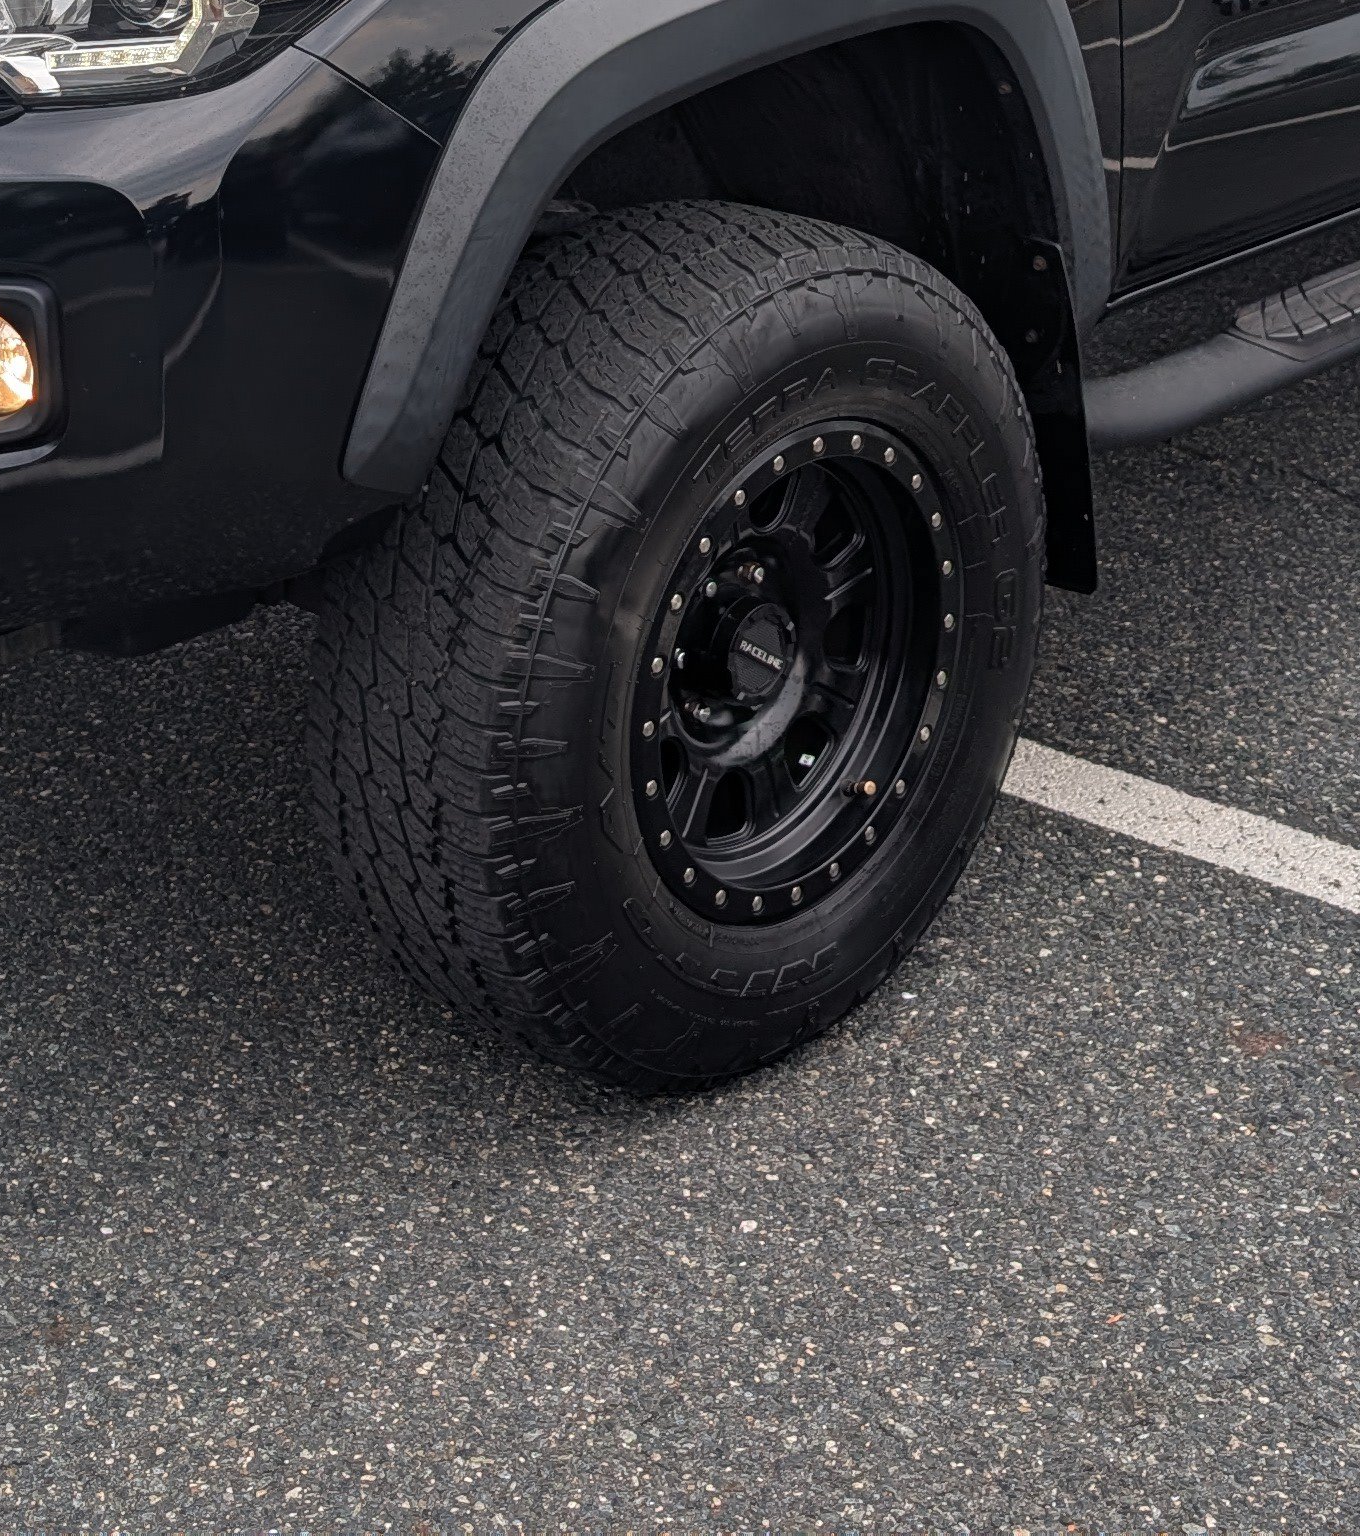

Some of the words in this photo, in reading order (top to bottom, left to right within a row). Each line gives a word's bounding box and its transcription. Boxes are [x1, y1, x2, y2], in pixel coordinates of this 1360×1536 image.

[693, 366, 836, 484] TERRA
[866, 357, 1009, 543] GRAPPLER
[739, 639, 784, 672] RACELINE
